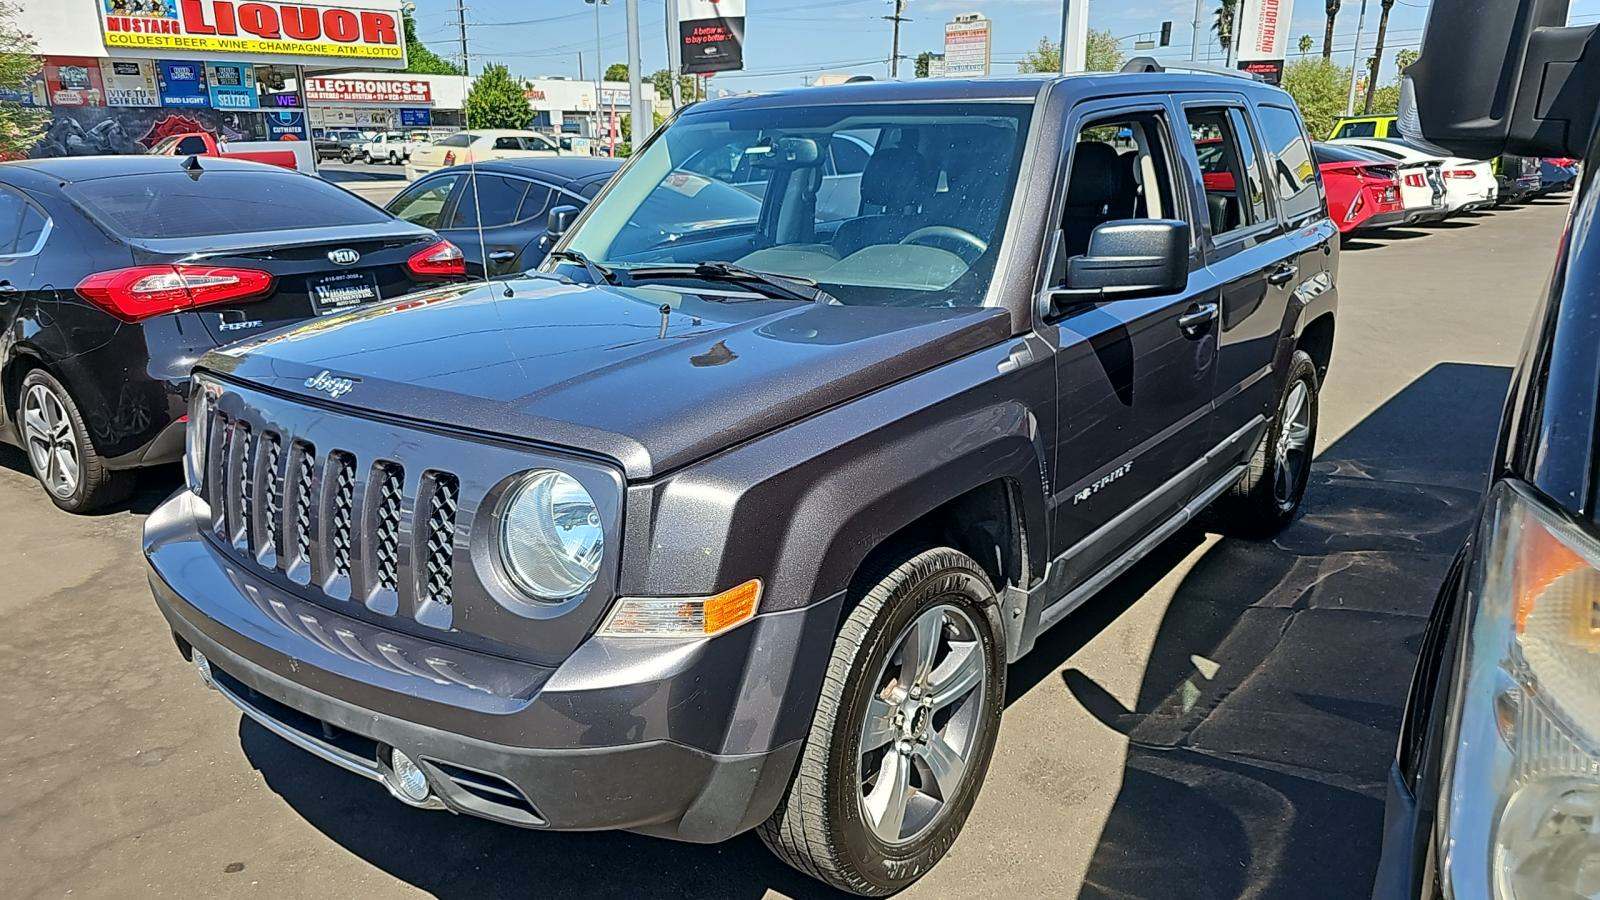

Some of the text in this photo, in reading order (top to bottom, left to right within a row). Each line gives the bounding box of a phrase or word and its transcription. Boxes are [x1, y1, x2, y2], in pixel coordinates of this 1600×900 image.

[106, 16, 181, 35] MUSTANG
[181, 0, 398, 44] LIQUOR
[109, 34, 400, 57] COLDEST BEER WINE CHAMPAGNE ATM LOTTO
[109, 97, 155, 105] ESTRELLA!
[134, 90, 147, 98] TU
[217, 94, 251, 107] SELTZER
[335, 251, 357, 263] KIA
[315, 284, 370, 299] WHOLESALE
[220, 320, 263, 332] FORTE
[303, 370, 353, 399] Jeep
[1073, 460, 1135, 506] PATRIOT
